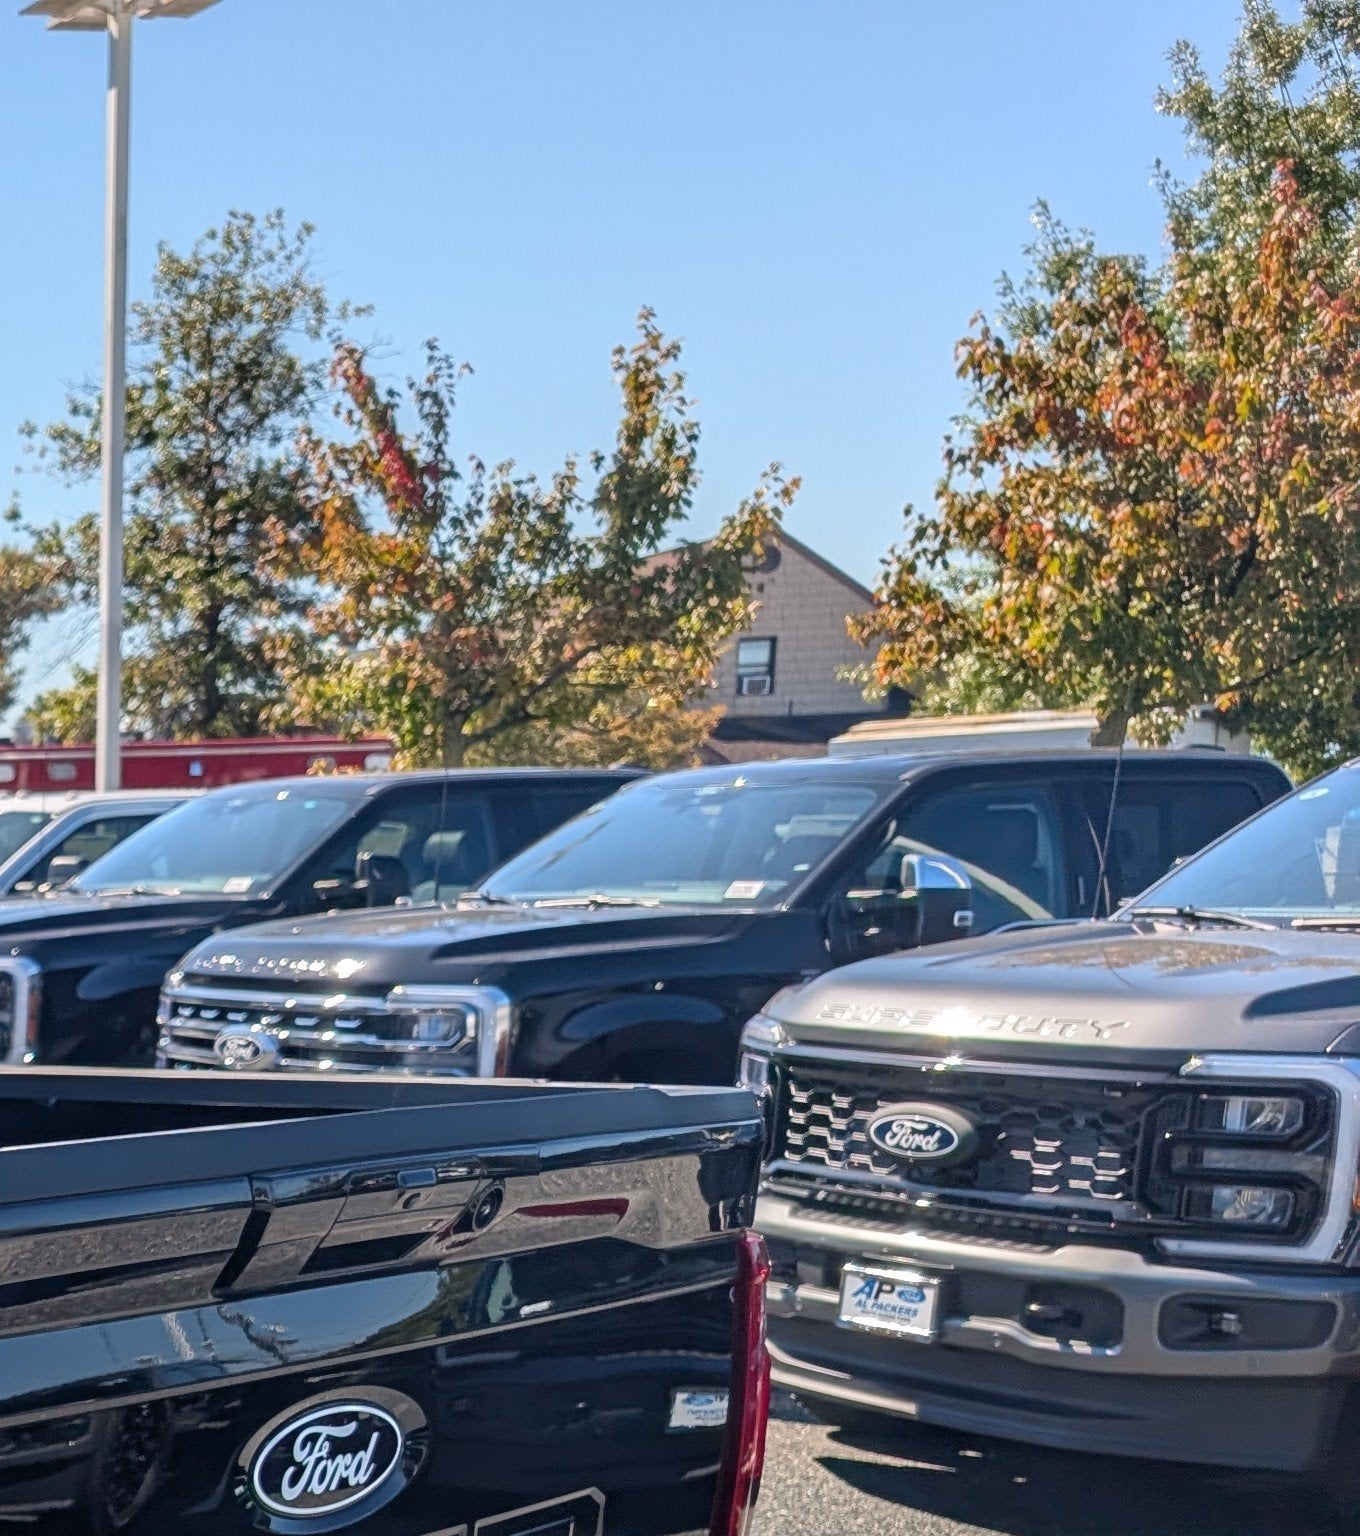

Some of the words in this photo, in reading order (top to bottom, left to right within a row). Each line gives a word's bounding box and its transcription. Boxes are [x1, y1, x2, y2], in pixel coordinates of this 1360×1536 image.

[816, 1003, 974, 1036] SUPE
[884, 1120, 942, 1152] Ford
[281, 1420, 380, 1501] Ford
